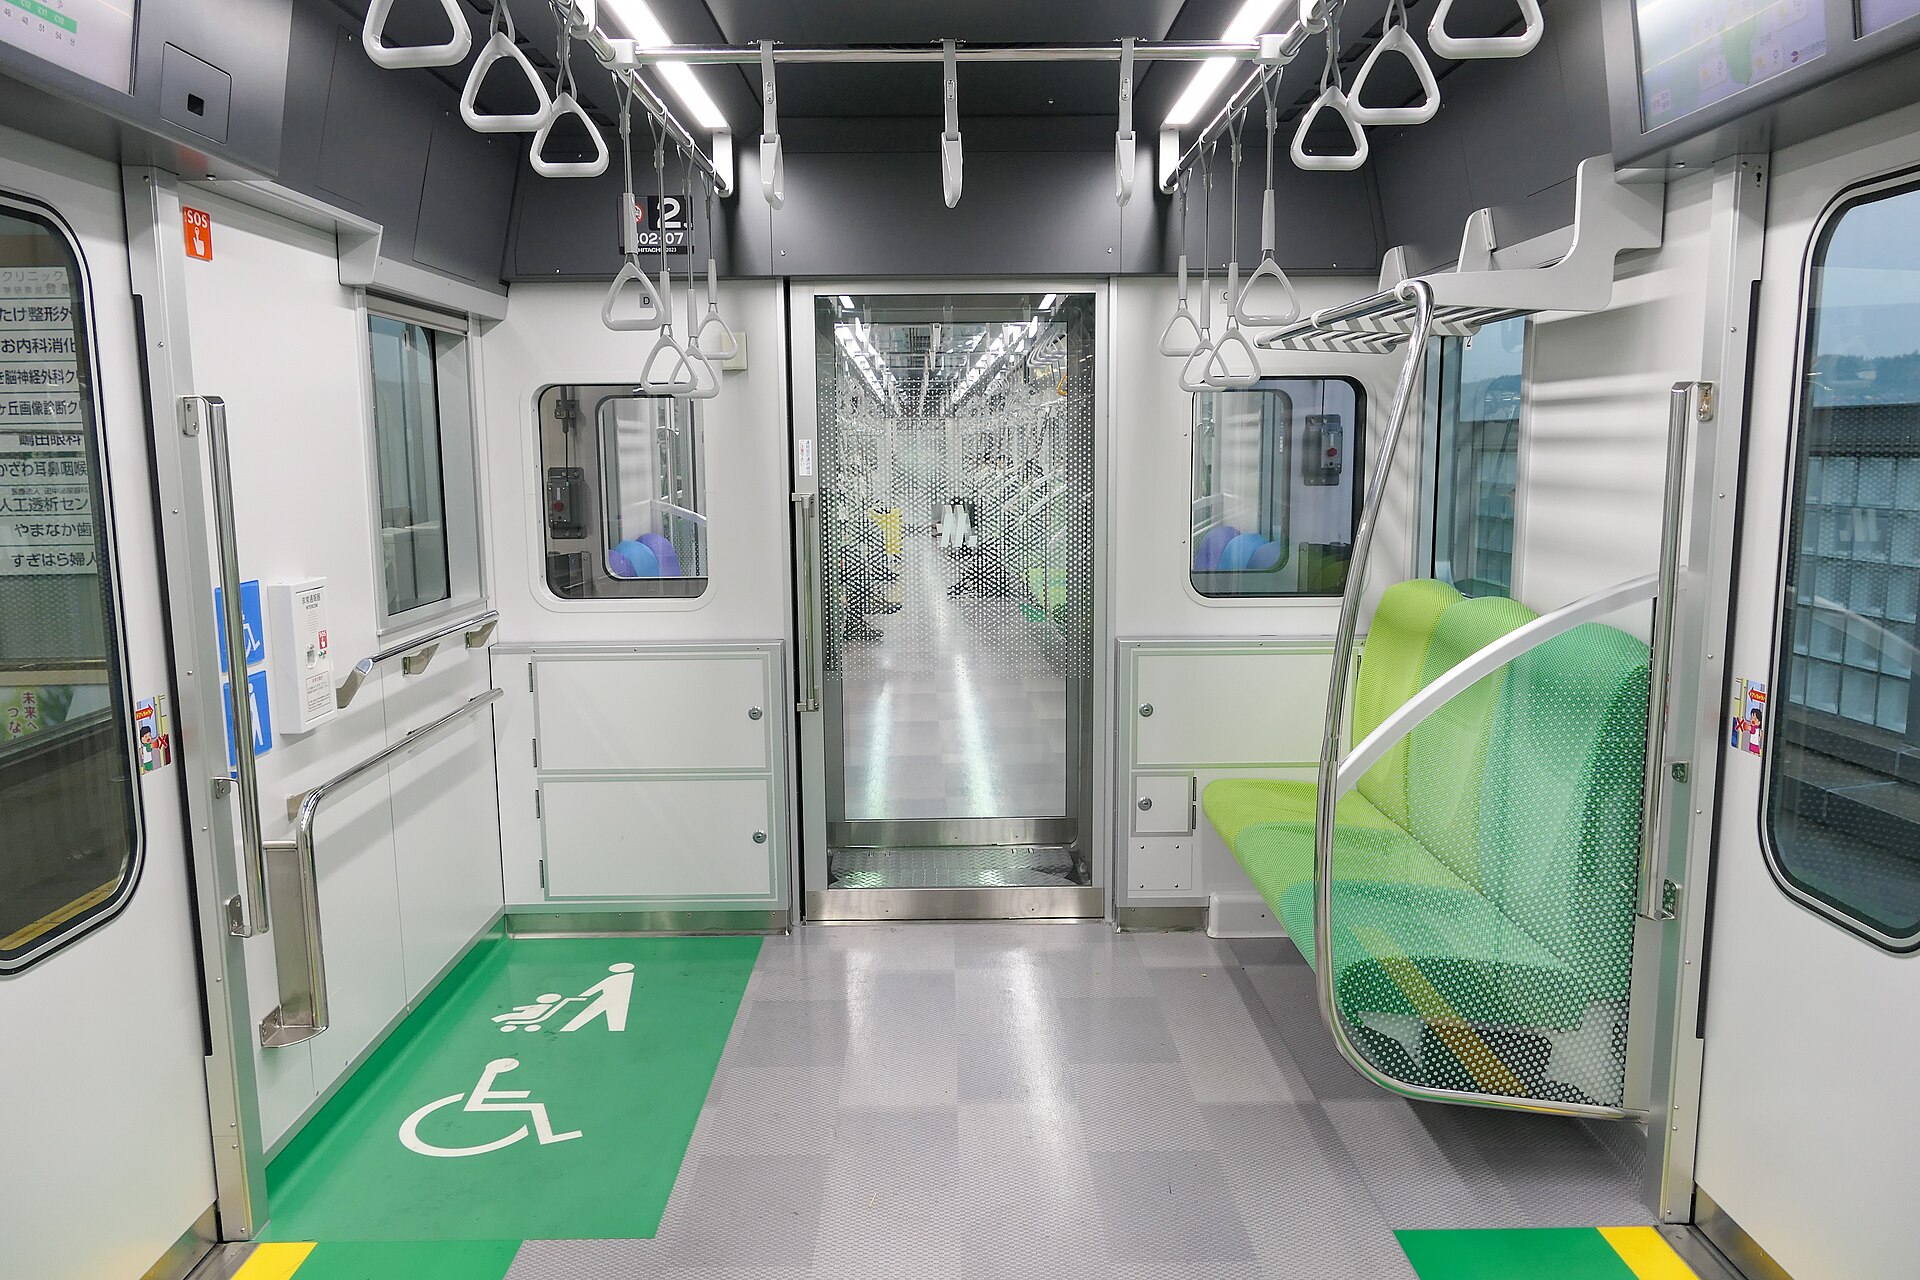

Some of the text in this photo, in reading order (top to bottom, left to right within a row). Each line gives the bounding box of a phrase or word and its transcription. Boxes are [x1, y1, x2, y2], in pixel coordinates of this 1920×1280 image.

[38, 23, 45, 33] 51
[187, 210, 208, 228] SOS
[657, 197, 681, 229] 2
[3, 271, 63, 281] クリニック
[643, 296, 651, 305] D
[14, 521, 92, 537] やまなか歯
[11, 551, 97, 567] すぎはら婦人
[23, 692, 37, 729] 未来へ
[7, 707, 21, 739] つな
